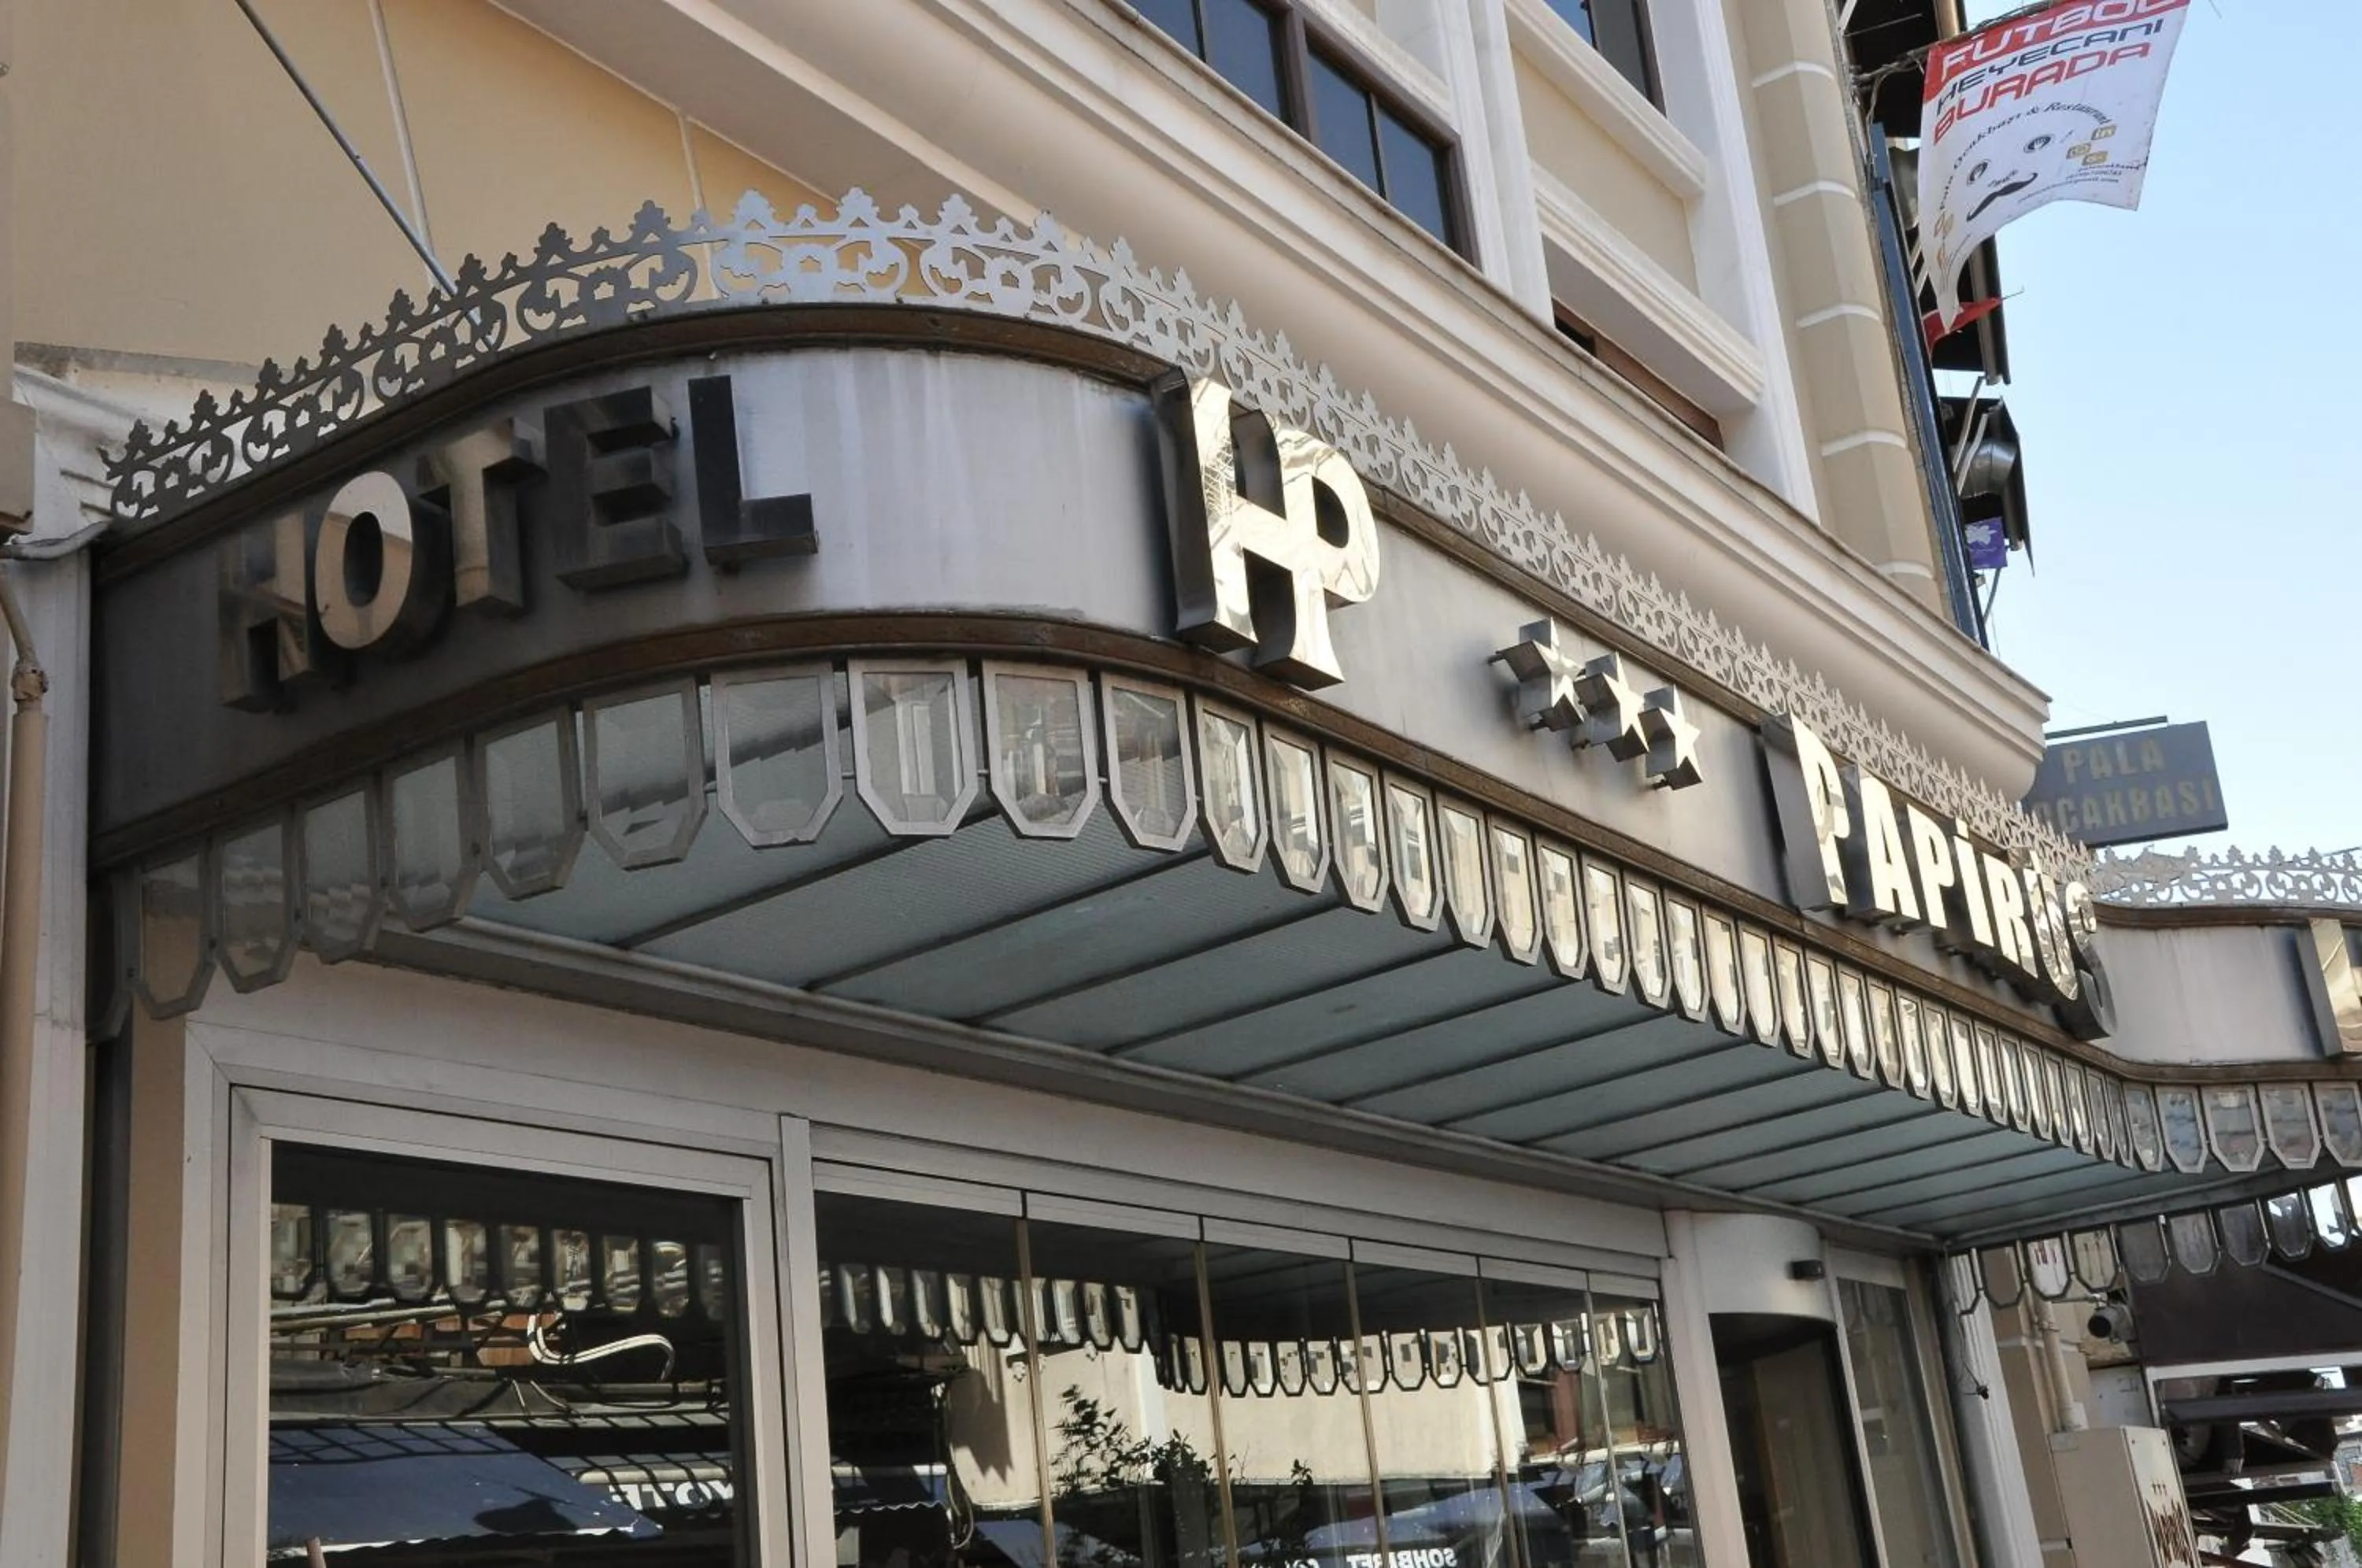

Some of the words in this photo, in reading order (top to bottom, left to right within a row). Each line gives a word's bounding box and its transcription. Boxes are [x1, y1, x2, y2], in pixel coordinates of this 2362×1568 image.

[1933, 42, 2151, 146] BURADA
[1936, 18, 2164, 116] HEYECANI
[219, 373, 816, 707] HOTEL
[2060, 737, 2166, 784] PALA
